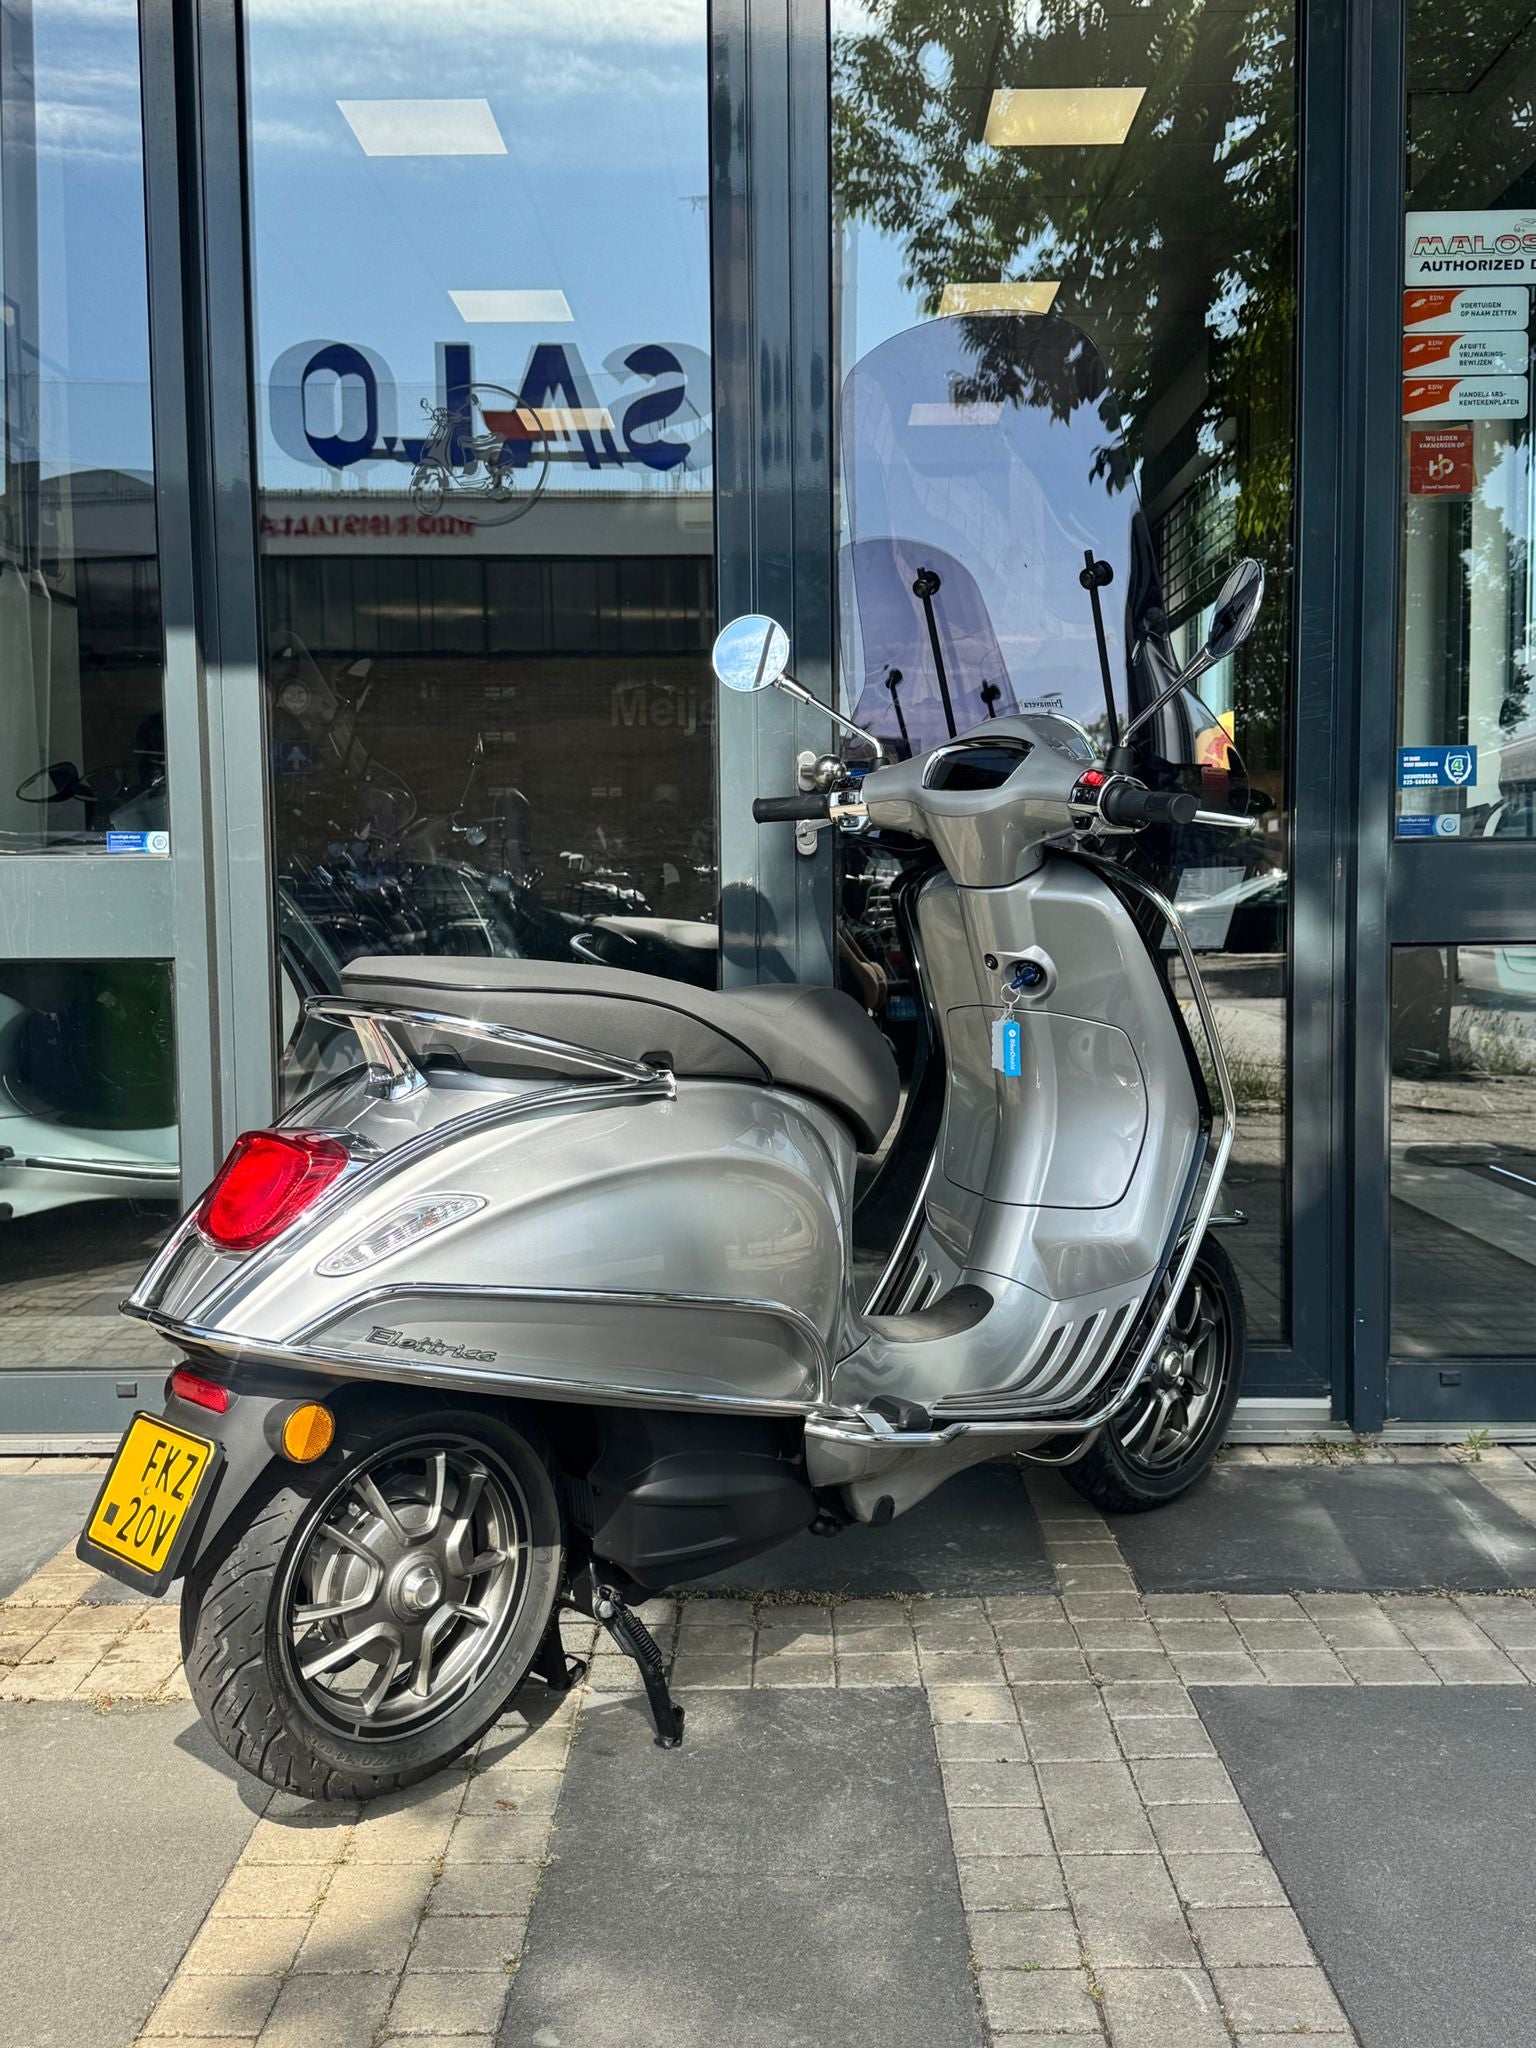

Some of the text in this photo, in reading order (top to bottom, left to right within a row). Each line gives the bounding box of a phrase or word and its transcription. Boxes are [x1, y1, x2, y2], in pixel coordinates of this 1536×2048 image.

[1419, 259, 1525, 272] AUTHORIZED
[364, 1325, 498, 1363] Elettrica
[141, 1439, 199, 1501] FKZ
[115, 1496, 177, 1557] 20V
